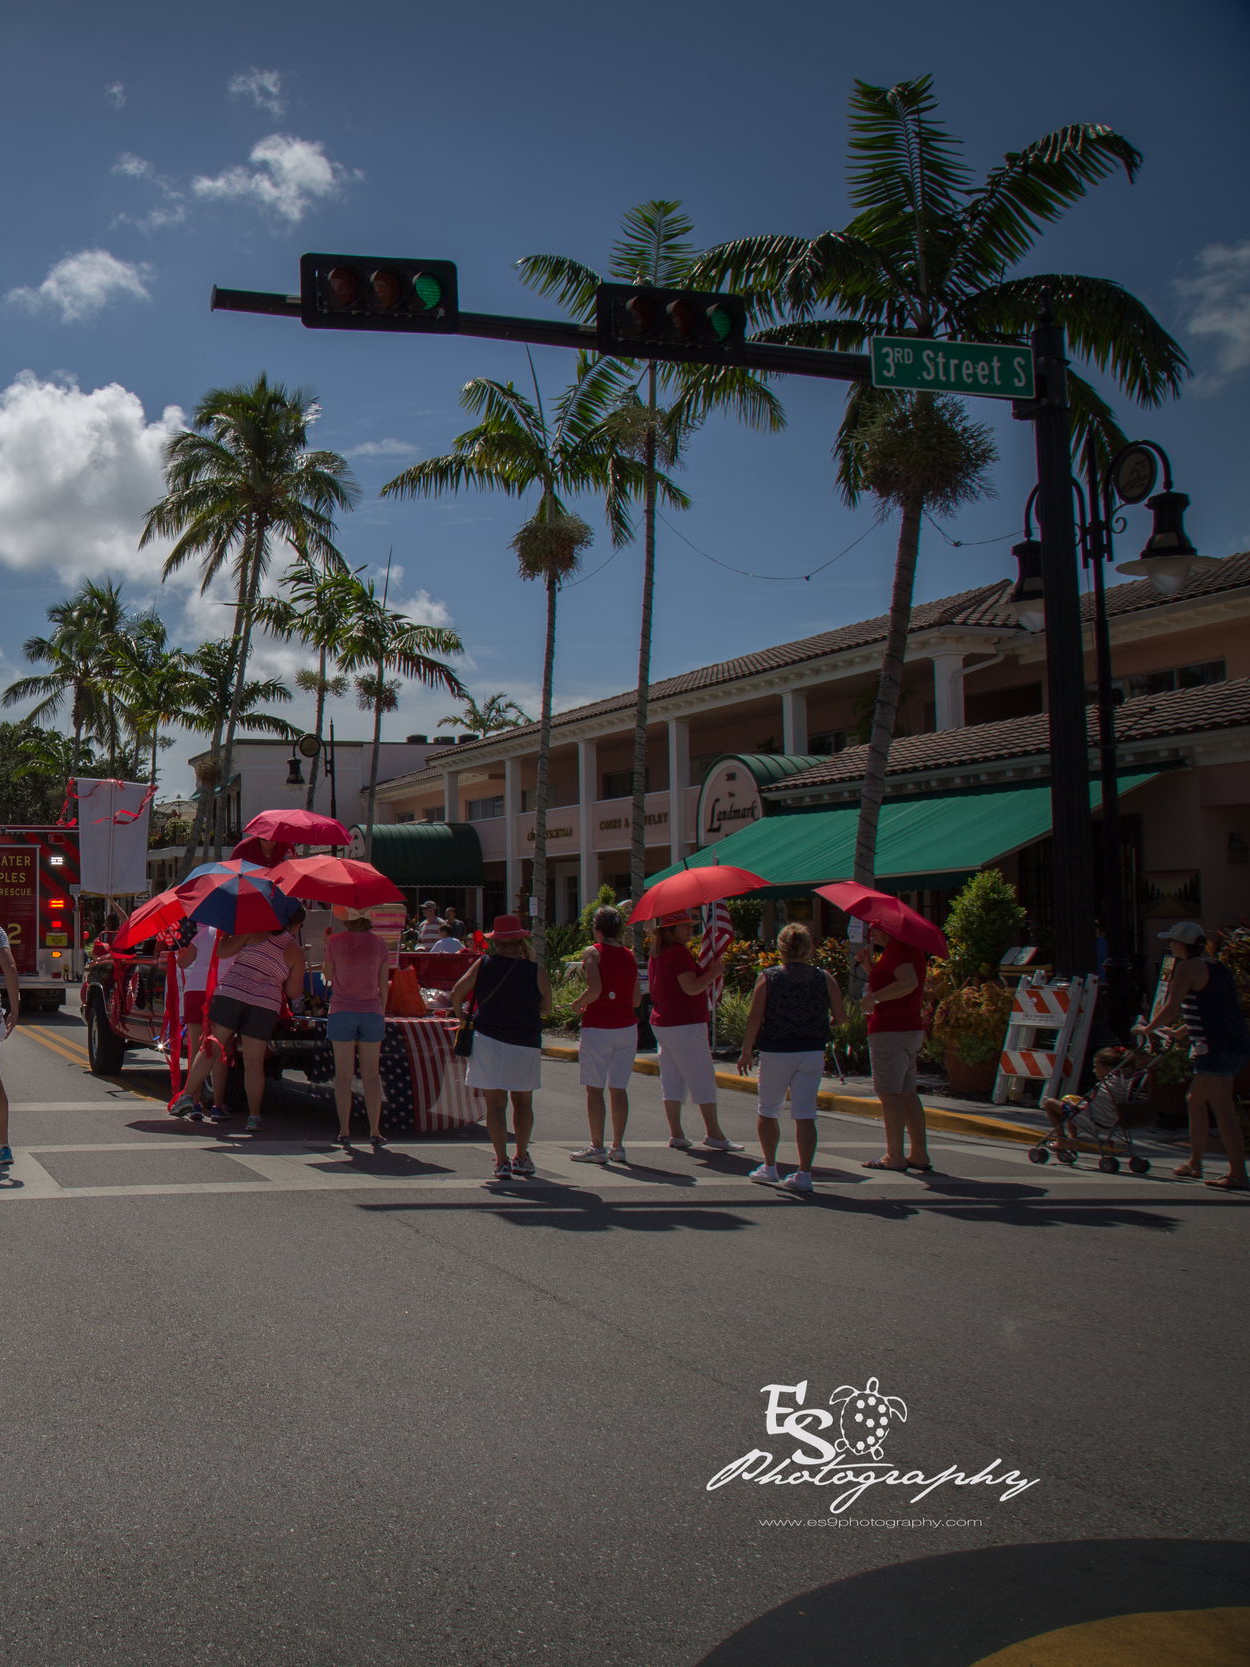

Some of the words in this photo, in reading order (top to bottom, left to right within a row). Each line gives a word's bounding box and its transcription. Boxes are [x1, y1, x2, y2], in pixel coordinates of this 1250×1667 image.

[881, 346, 914, 379] 3RD
[922, 349, 1002, 386] Street
[1013, 356, 1027, 387] S
[643, 812, 668, 826] ELRY
[707, 798, 757, 832] Landmark
[0, 888, 31, 896] RESCUE
